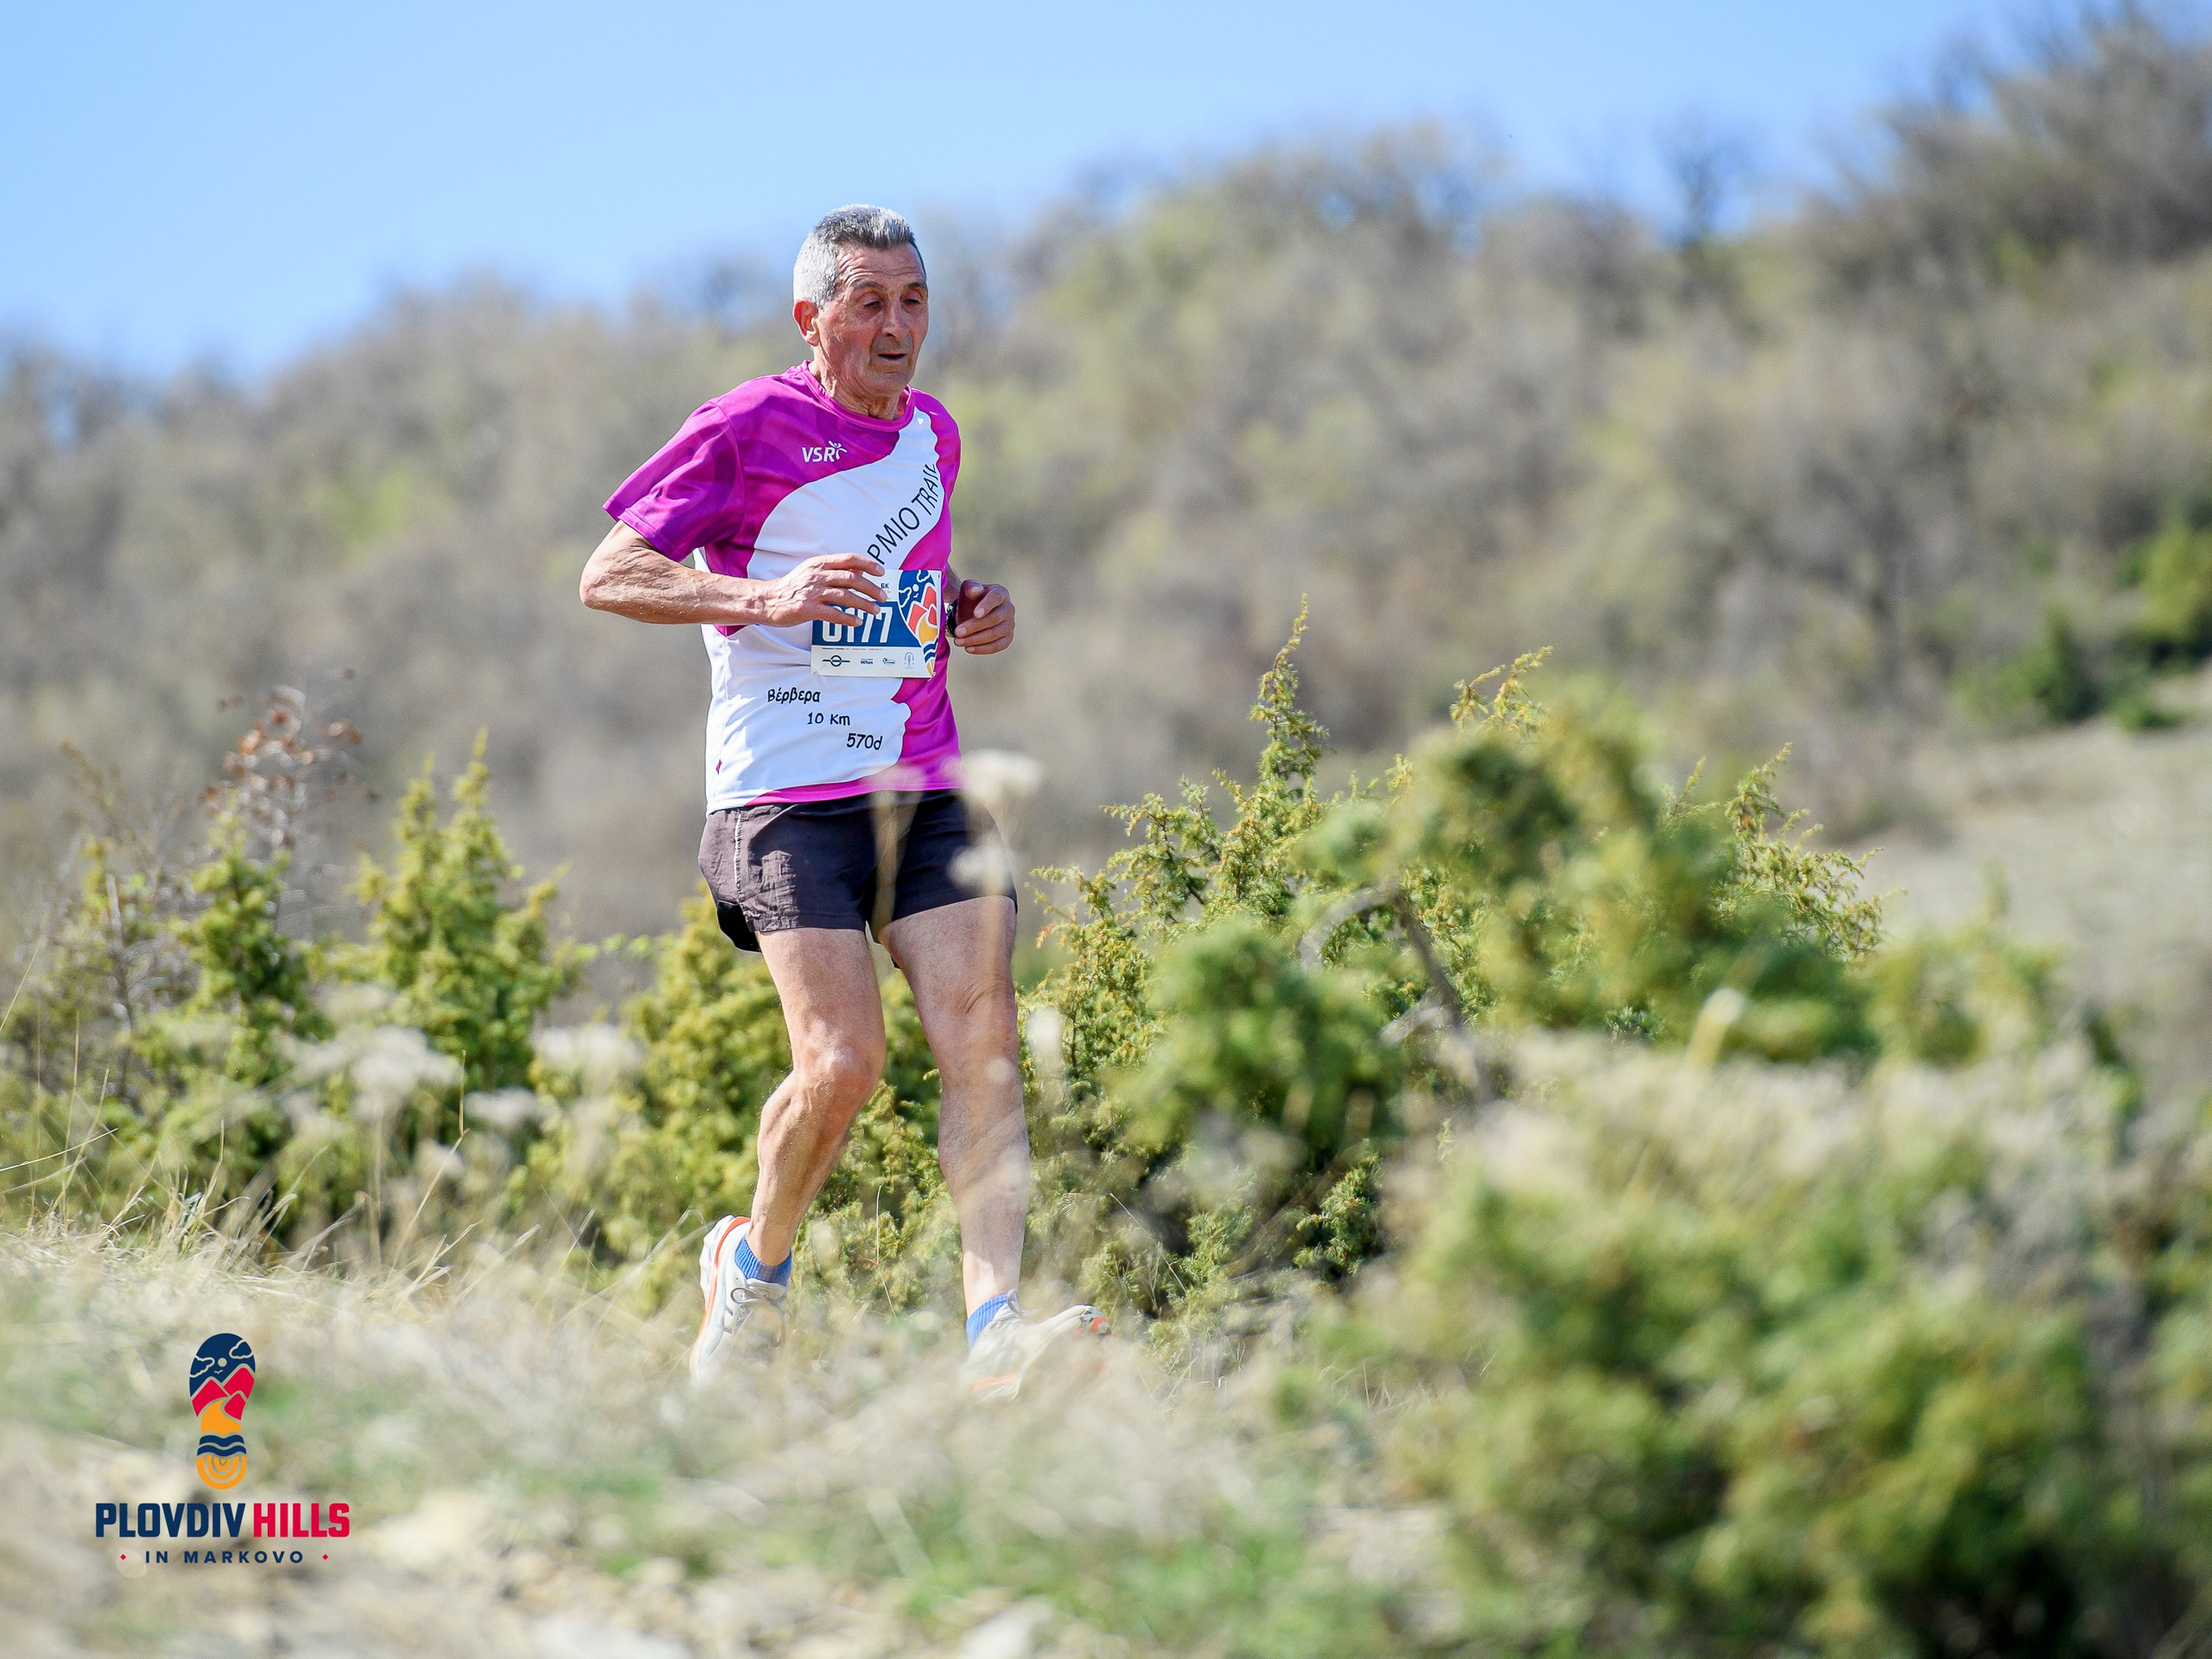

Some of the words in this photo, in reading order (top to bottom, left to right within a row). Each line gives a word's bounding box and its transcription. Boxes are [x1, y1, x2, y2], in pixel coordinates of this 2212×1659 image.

[911, 463, 939, 516] TRAIL
[807, 712, 824, 725] 10
[846, 732, 883, 751] 570d
